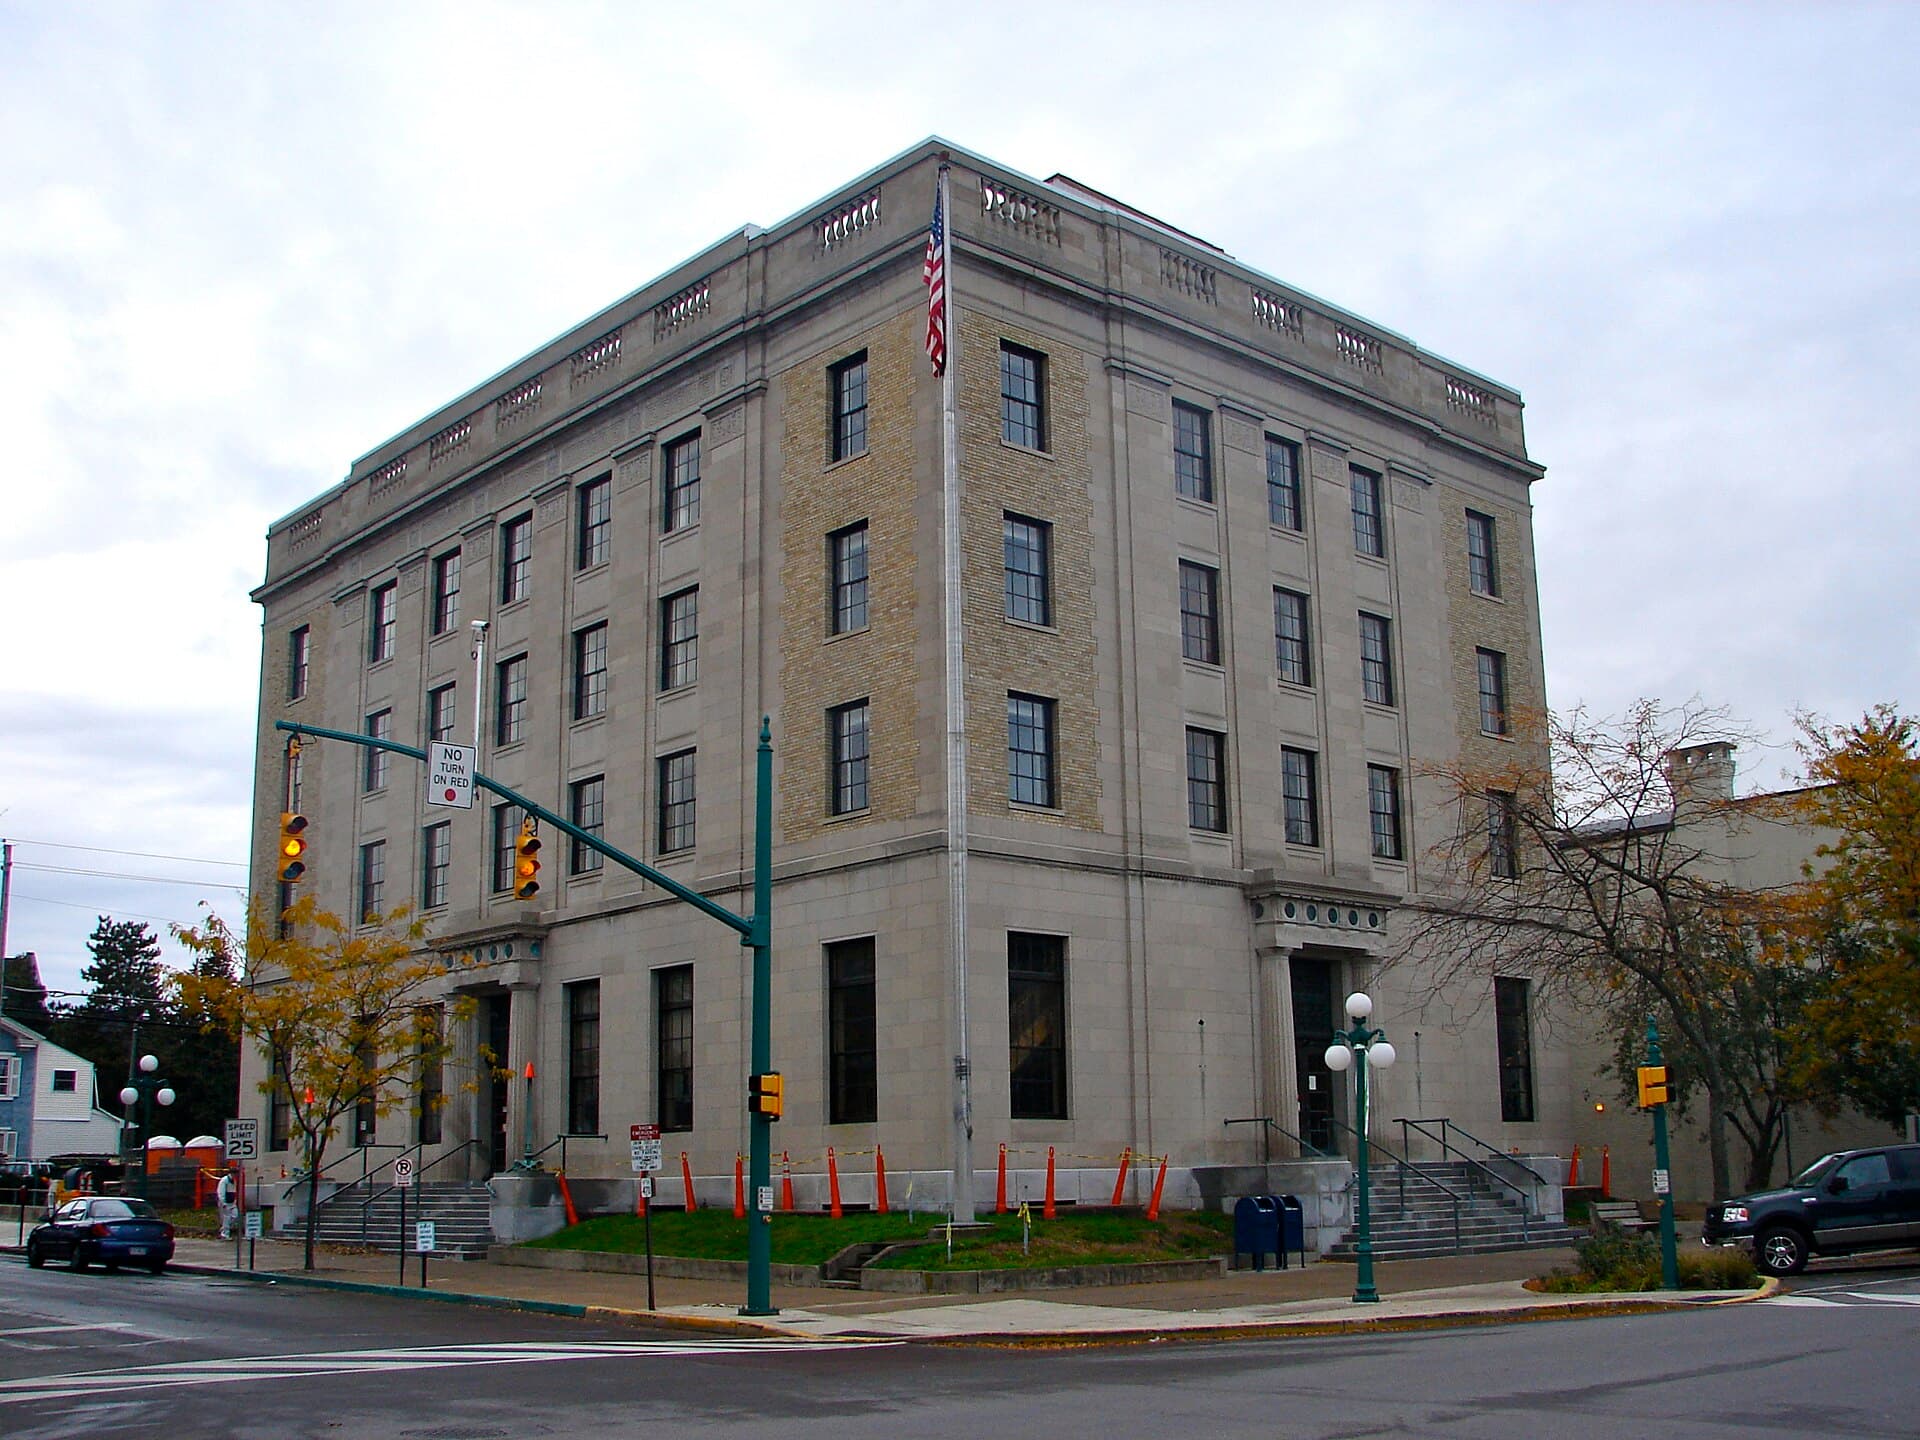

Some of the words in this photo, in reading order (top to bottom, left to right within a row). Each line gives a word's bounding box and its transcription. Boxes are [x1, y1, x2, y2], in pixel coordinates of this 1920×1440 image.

[444, 748, 462, 761] NO
[440, 762, 465, 775] TURN
[433, 774, 447, 785] ON
[450, 776, 469, 788] RED
[231, 1131, 252, 1139] LIMIT
[229, 1140, 254, 1155] 25
